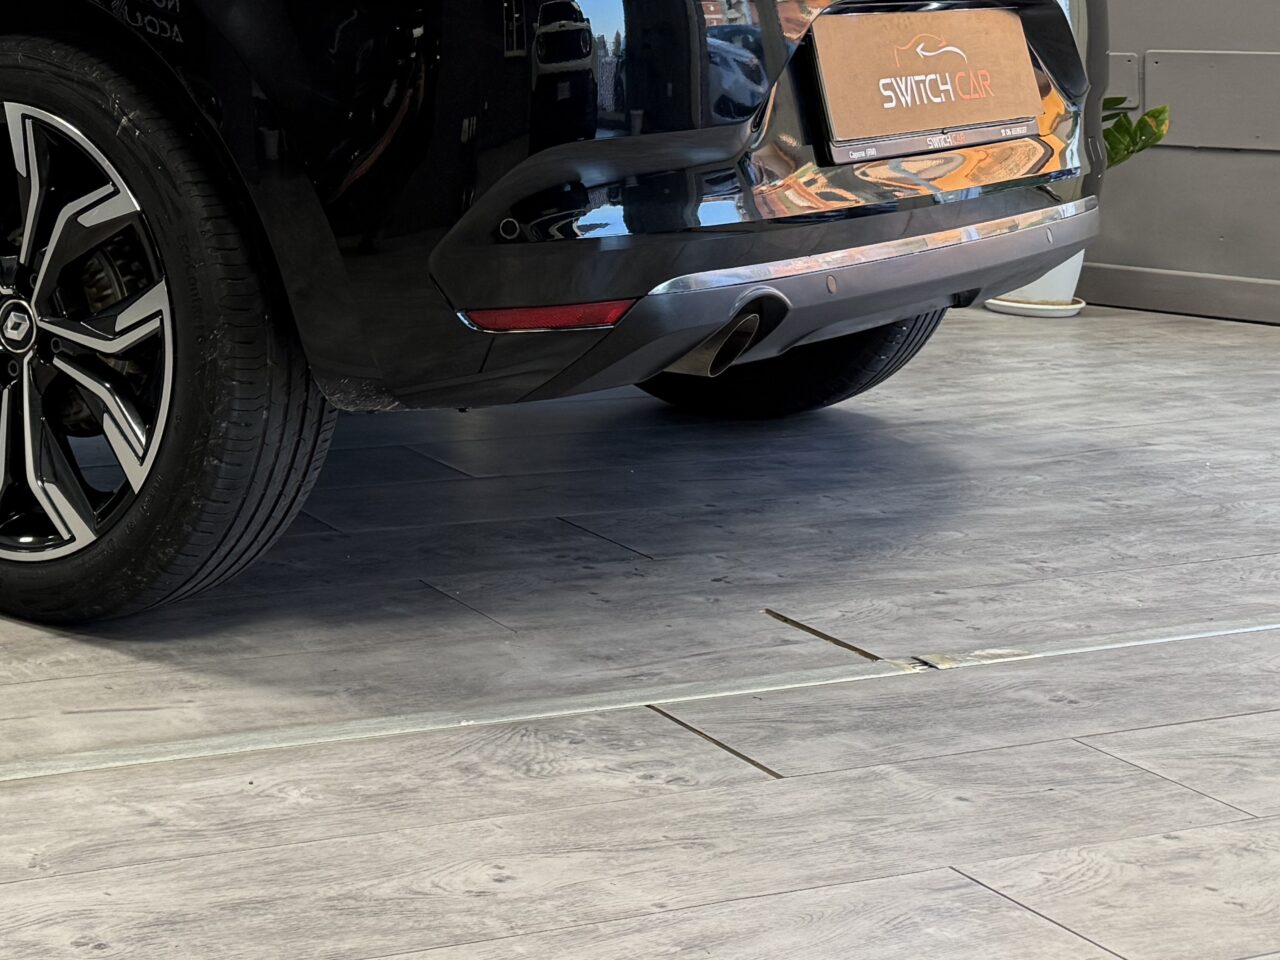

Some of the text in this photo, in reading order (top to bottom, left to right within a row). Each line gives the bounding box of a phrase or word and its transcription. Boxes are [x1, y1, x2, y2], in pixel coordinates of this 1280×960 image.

[879, 69, 995, 109] SWITCH CAR
[926, 134, 951, 149] SWITCH
